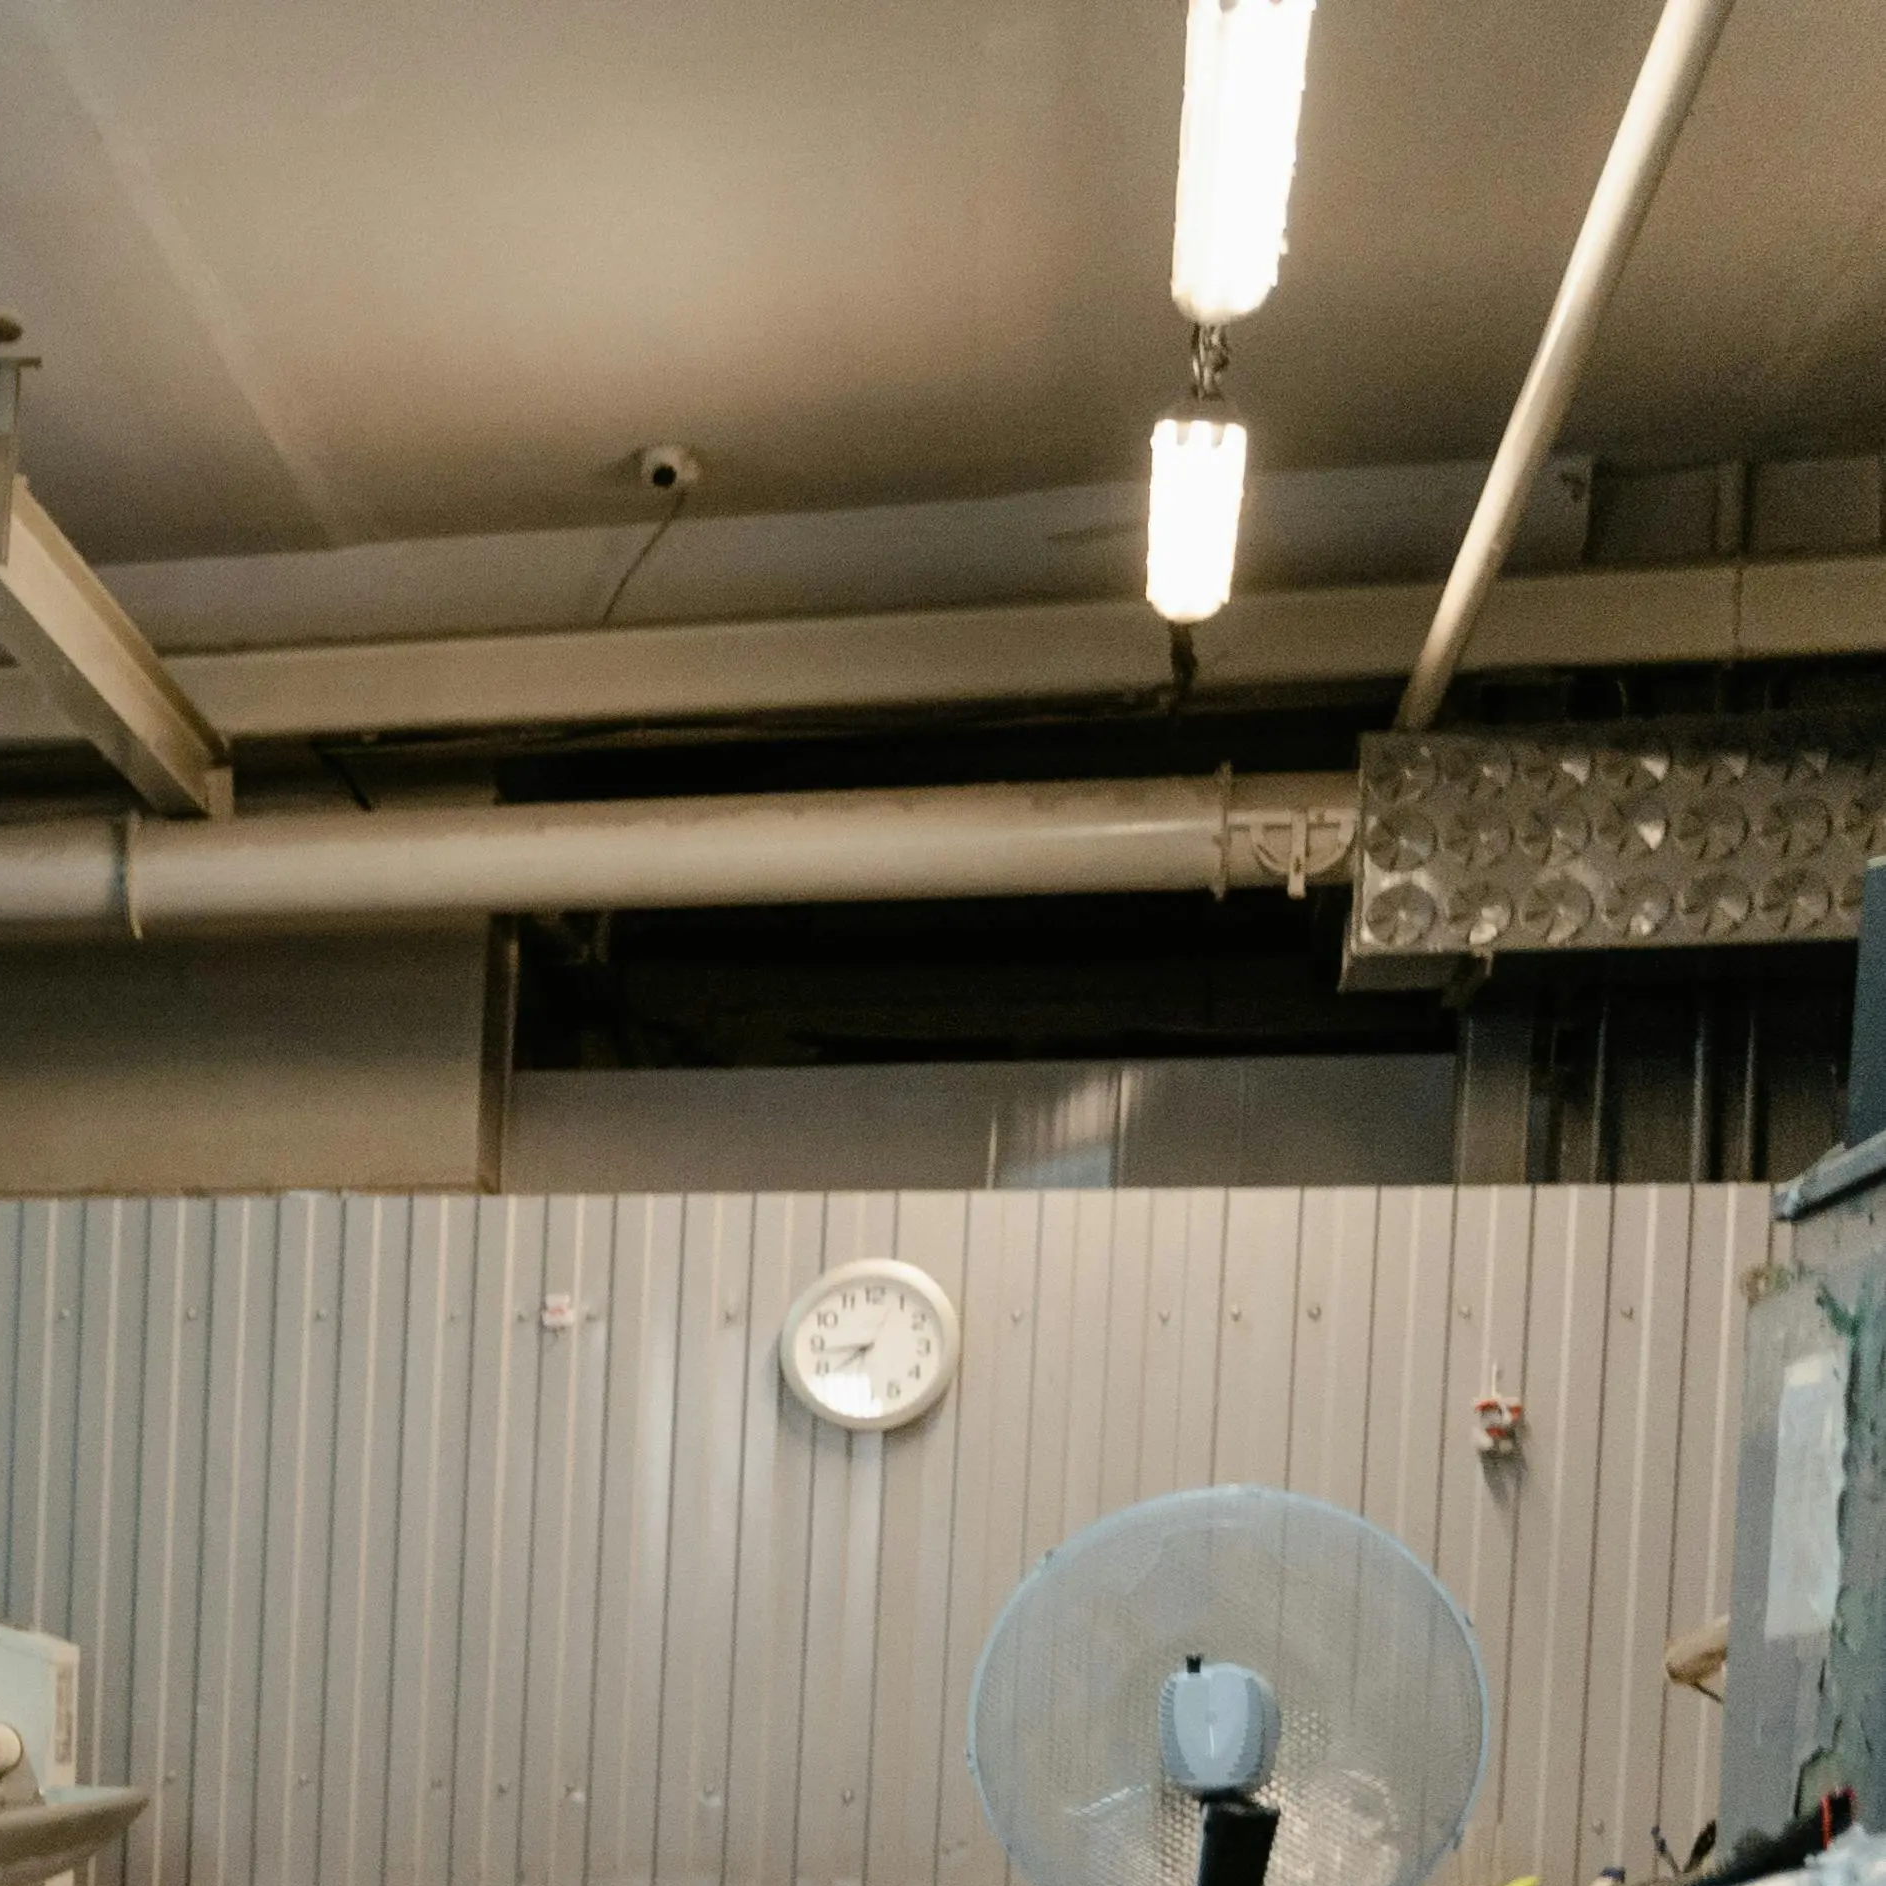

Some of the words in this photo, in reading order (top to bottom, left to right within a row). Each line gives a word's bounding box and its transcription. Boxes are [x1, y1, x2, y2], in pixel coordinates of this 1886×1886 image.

[842, 1293, 855, 1311] 11
[865, 1286, 886, 1305] 12
[817, 1311, 838, 1329] 10
[911, 1312, 926, 1332] 2
[810, 1334, 825, 1354] 9
[916, 1337, 931, 1357] 3
